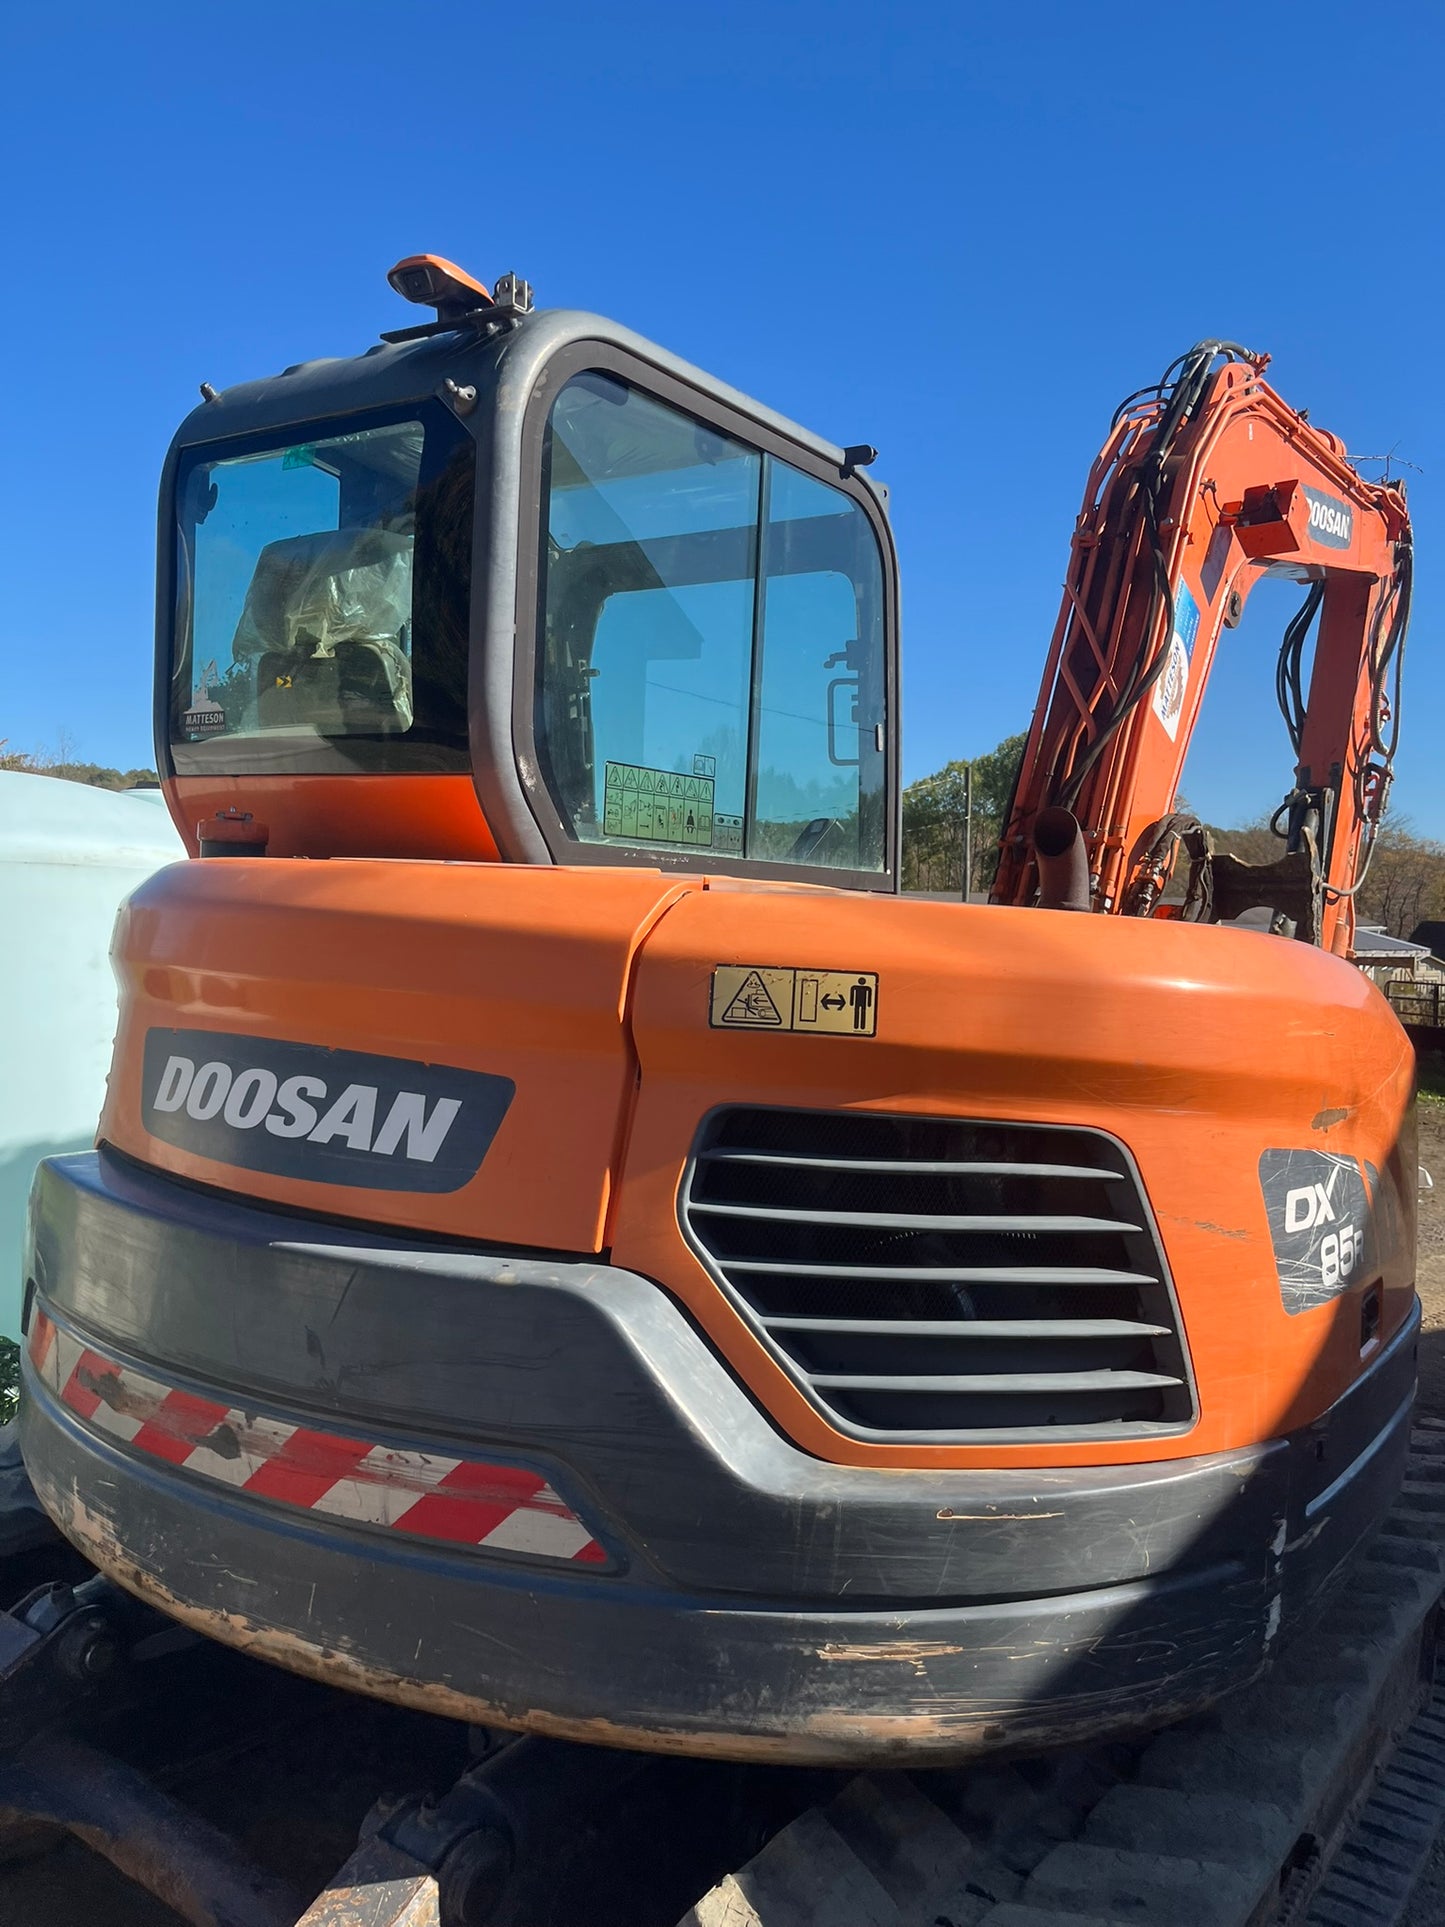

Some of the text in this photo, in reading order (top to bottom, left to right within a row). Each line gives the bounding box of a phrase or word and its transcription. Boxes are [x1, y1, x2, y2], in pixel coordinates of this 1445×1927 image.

[1161, 642, 1180, 720] MATTESON
[185, 713, 224, 725] MATTESON
[153, 1056, 463, 1162] DOOSAN
[1285, 1165, 1339, 1233] DX
